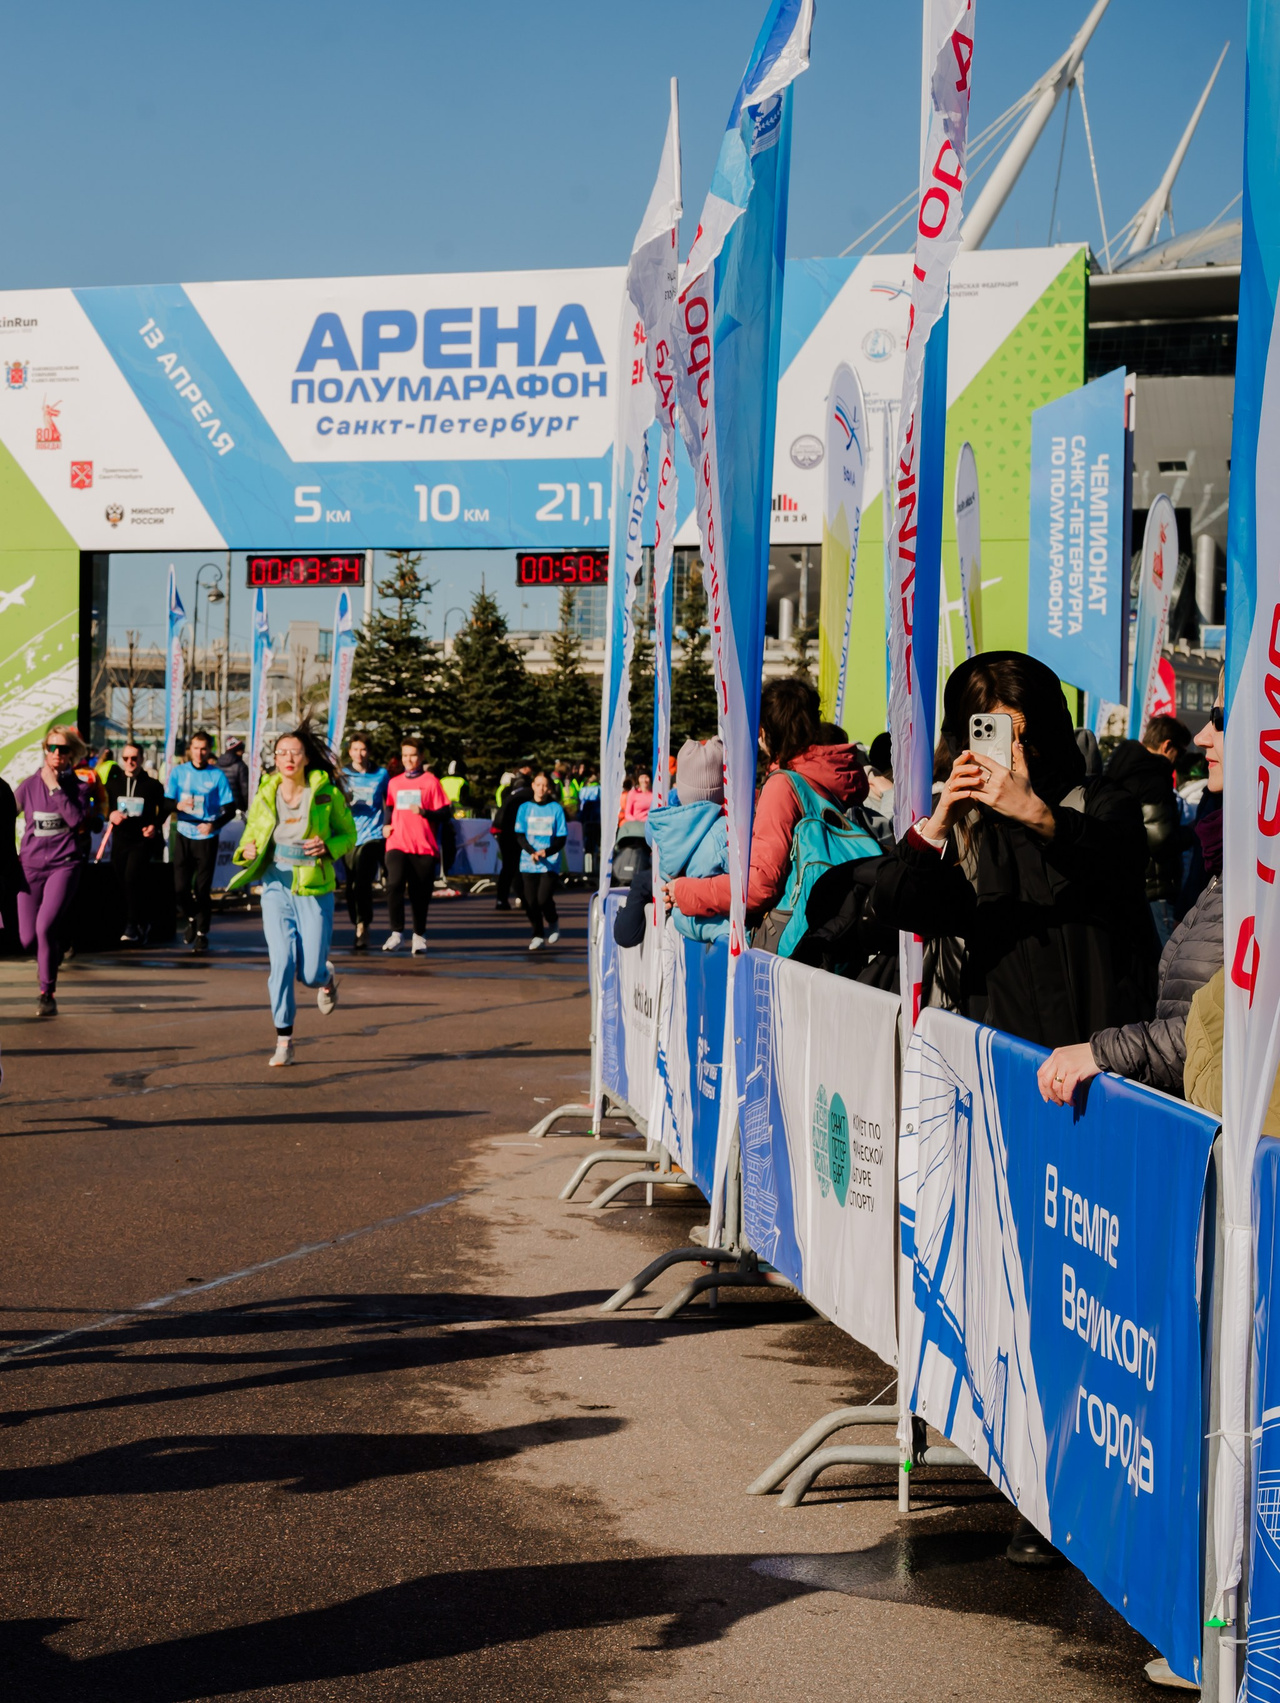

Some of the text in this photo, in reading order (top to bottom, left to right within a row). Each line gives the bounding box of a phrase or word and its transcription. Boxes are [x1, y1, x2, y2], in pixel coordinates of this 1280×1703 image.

[295, 303, 606, 373] АРЕНА
[139, 318, 235, 456] 13 АПРЕЛЯ
[291, 371, 608, 404] ПОЛУМАРАФОН
[317, 412, 580, 439] Санкт-Петербург
[131, 507, 175, 515] МИНСПОРТ
[131, 517, 164, 525] РОССИИ
[294, 486, 322, 523] 5
[414, 484, 460, 522] 10
[1048, 436, 1067, 640] ПО ПОЛУМАРАФОНУ
[1067, 434, 1087, 636] САНКТ-ПЕТЕРБУРГА
[1087, 453, 1110, 616] ЧЕМПИОНАТ
[251, 557, 360, 585] 00:03:34
[1044, 1162, 1120, 1270] В темпе
[1062, 1262, 1157, 1392] Великого
[1075, 1384, 1155, 1497] города
